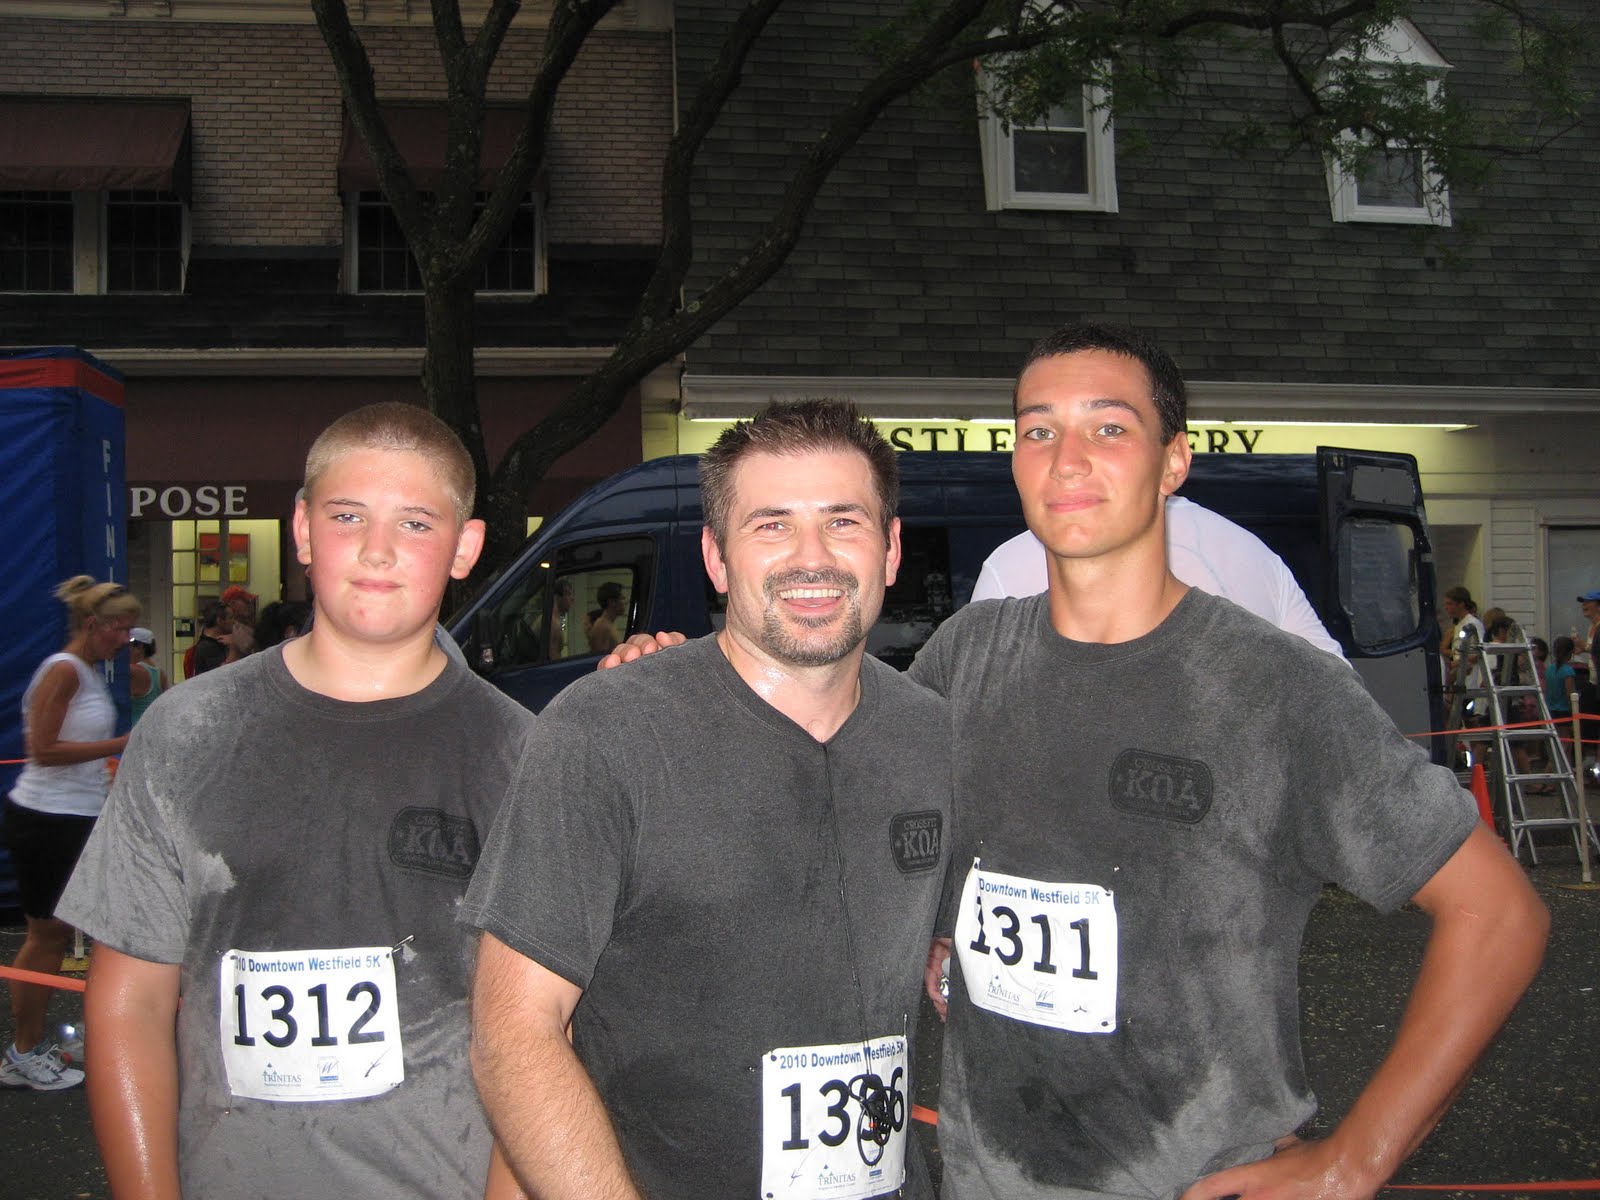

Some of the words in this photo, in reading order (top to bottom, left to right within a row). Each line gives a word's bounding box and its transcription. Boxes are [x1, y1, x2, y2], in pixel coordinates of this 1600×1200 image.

[130, 486, 248, 517] POSE
[103, 440, 116, 683] FINIH
[1124, 769, 1200, 810] KOA
[403, 824, 471, 865] KOA
[902, 828, 939, 858] KOA
[979, 878, 1027, 899] Downtown
[1031, 887, 1080, 904] Westfield
[1084, 891, 1100, 905] 5K
[970, 896, 1098, 980] 1311
[249, 958, 304, 972] Downtown
[308, 956, 361, 971] Westfield
[366, 955, 381, 968] 5K
[987, 984, 1021, 1002] TRINITAS
[235, 981, 385, 1047] 1312
[780, 1054, 807, 1069] 2010
[812, 1052, 862, 1068] Downtown
[863, 1042, 896, 1060] Westfield
[896, 1041, 904, 1054] 5K
[263, 1074, 302, 1083] TRINITAS
[818, 1173, 856, 1186] TRINITAS
